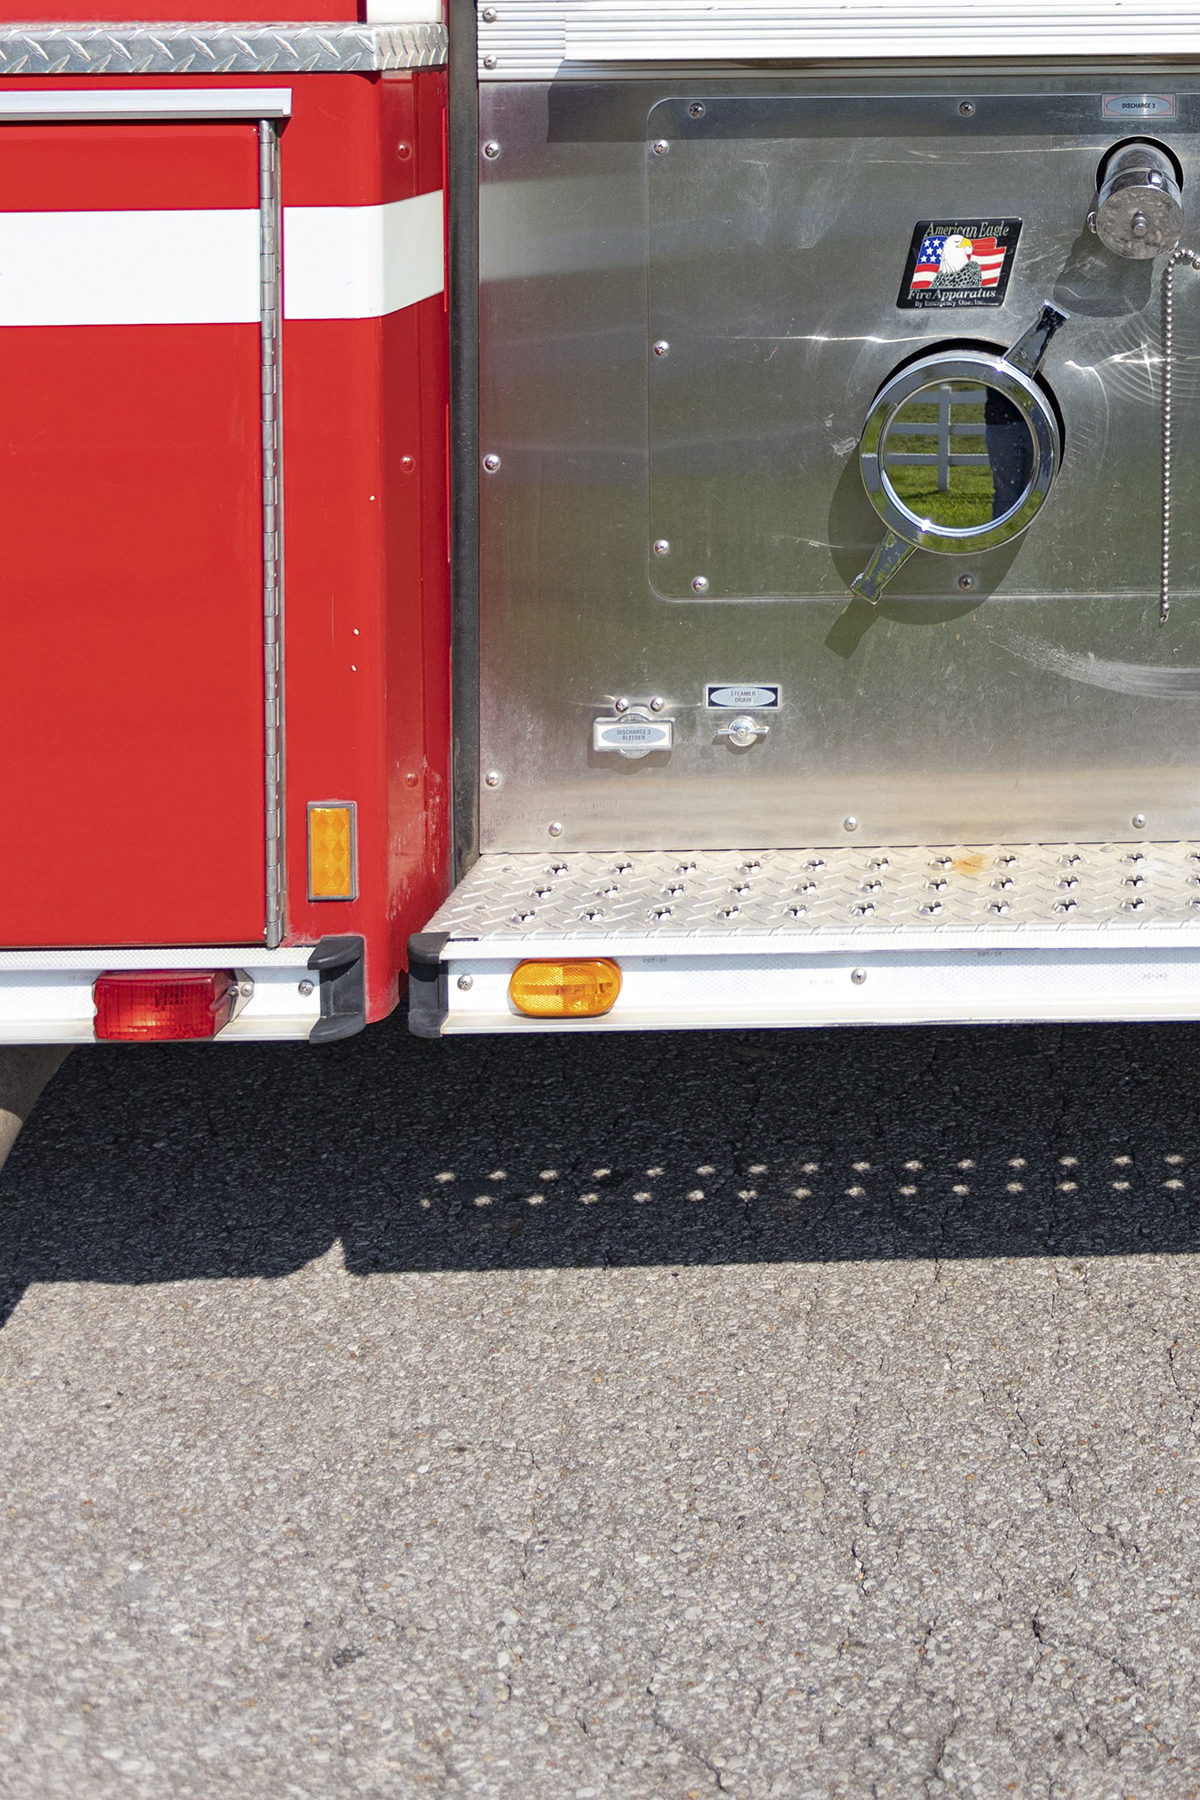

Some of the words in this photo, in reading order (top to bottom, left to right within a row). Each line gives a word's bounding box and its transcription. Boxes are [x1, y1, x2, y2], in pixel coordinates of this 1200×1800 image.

[924, 222, 978, 238] American
[978, 221, 1010, 238] Eagle
[907, 290, 932, 300] Fire
[932, 289, 997, 302] Apparatus
[924, 300, 956, 308] Emergency
